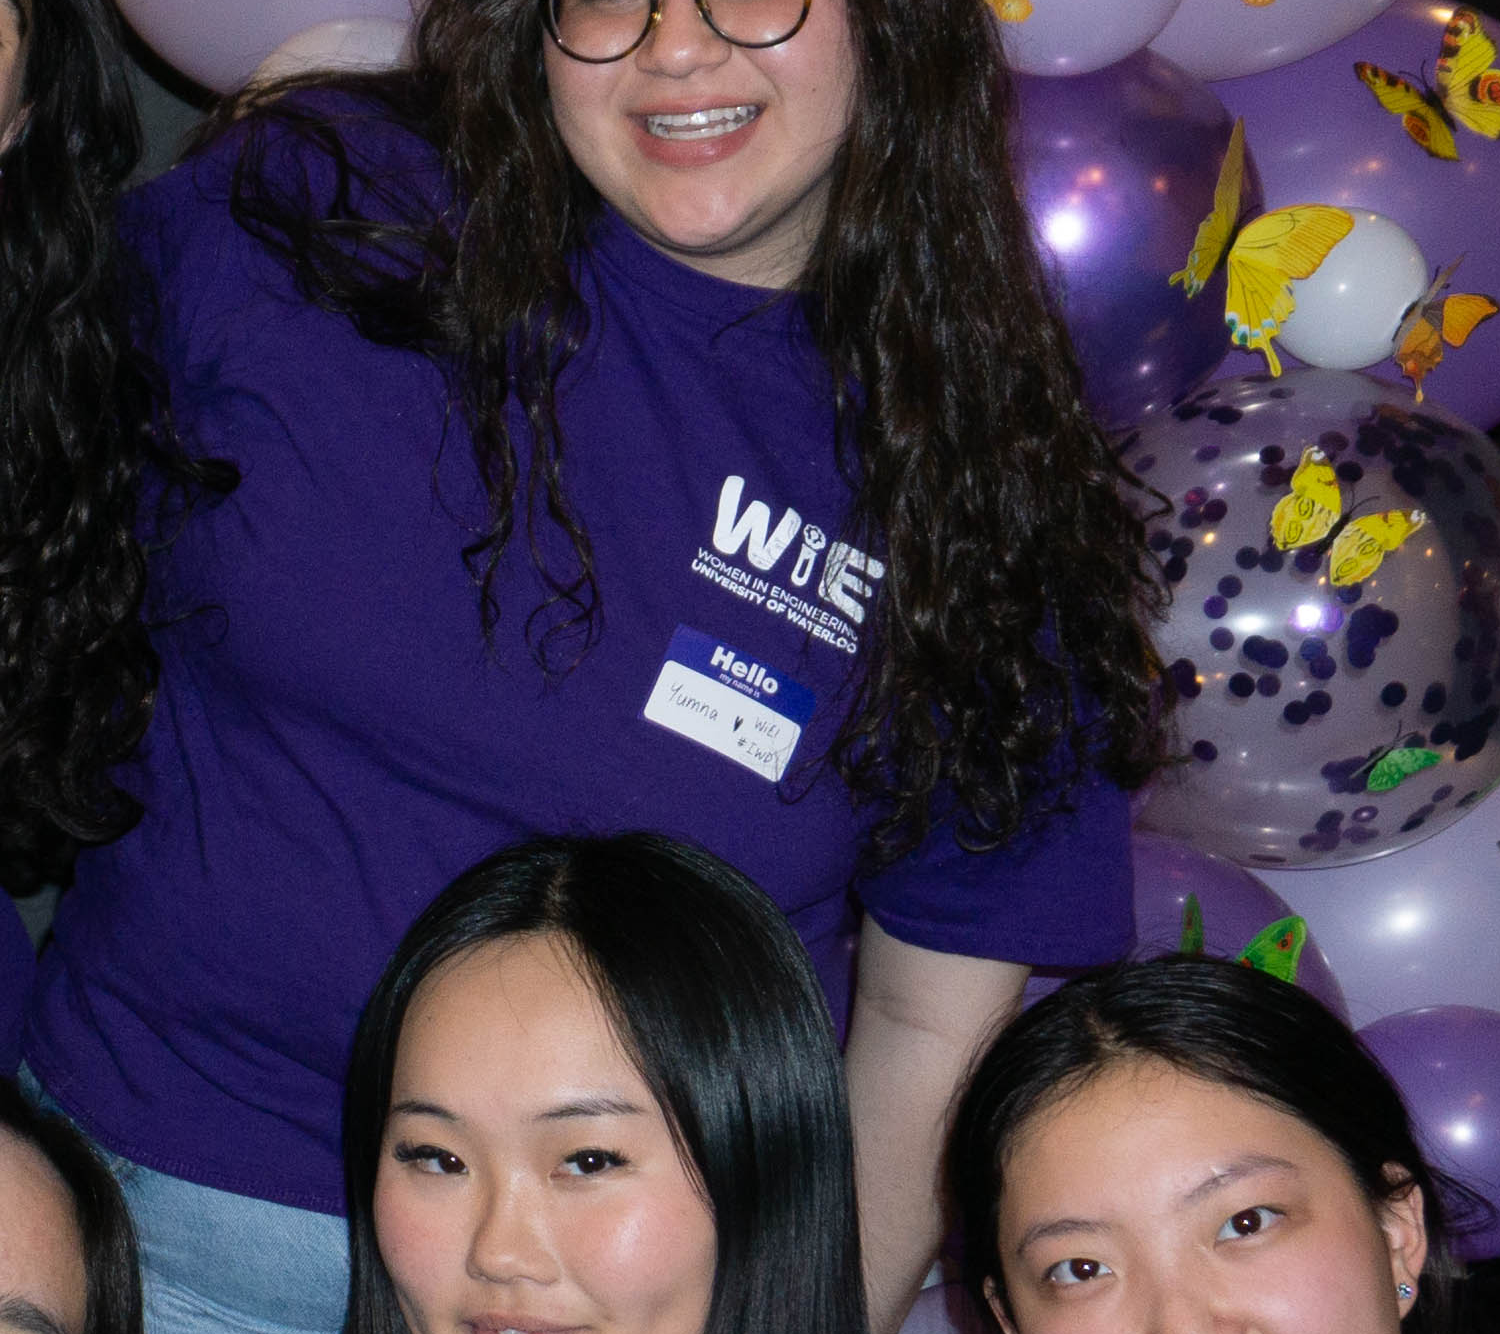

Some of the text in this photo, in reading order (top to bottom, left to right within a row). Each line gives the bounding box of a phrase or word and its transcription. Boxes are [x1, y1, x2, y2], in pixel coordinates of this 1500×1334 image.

[692, 559, 858, 654] UNIVERSITY OF WATERLOO
[698, 547, 859, 641] WOMEN IN ENGINEERING
[710, 645, 778, 694] Hello
[719, 673, 760, 698] my name is
